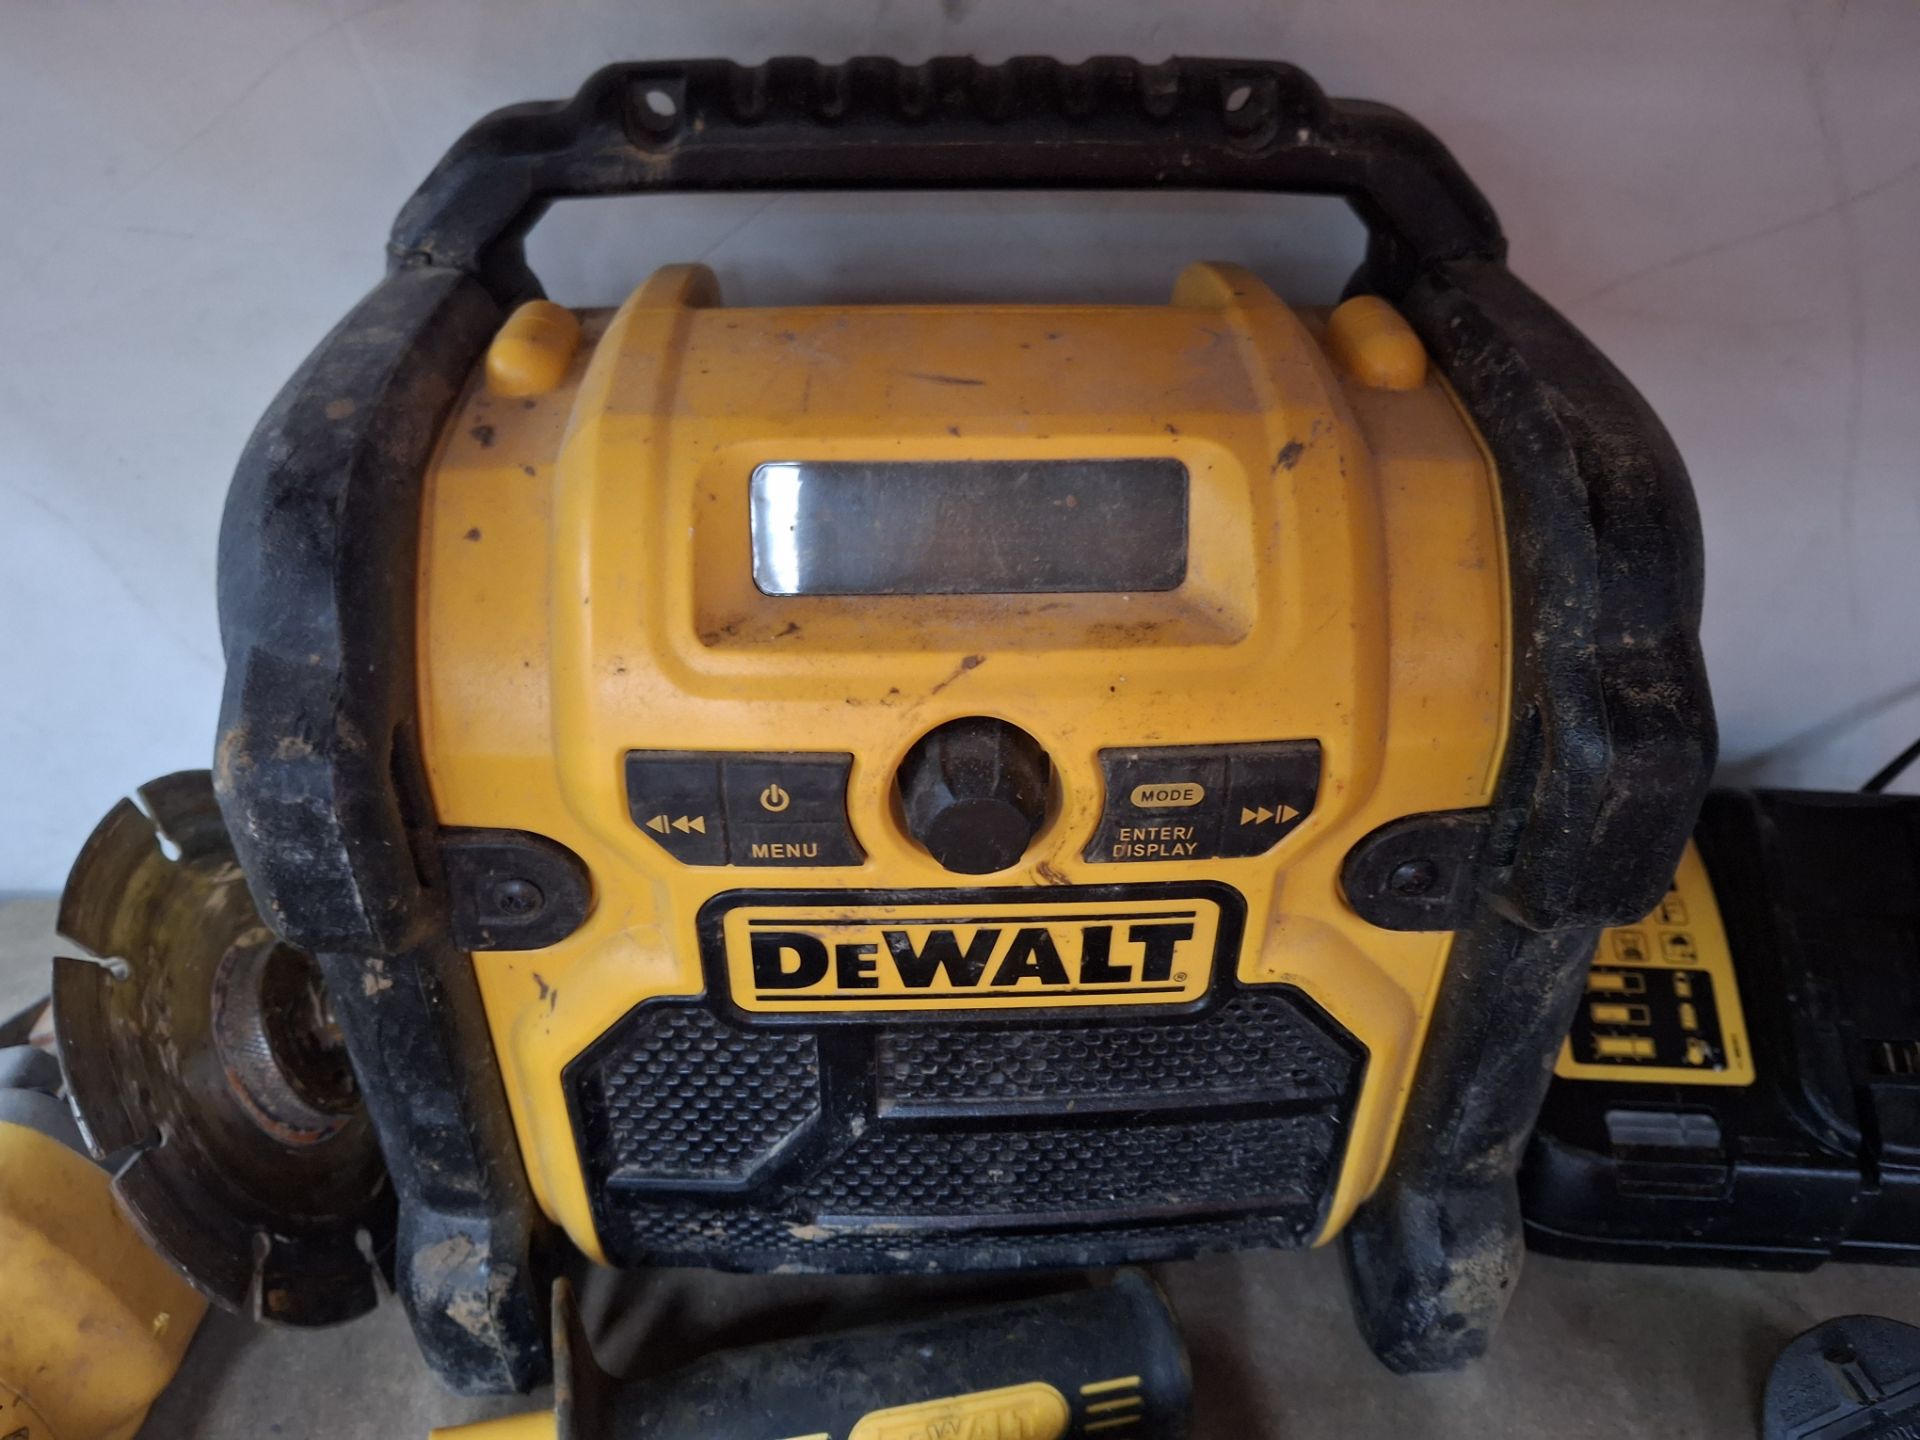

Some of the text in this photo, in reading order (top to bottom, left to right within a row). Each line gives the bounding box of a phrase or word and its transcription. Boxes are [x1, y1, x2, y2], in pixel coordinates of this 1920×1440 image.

[1141, 789, 1194, 802] MODE
[1120, 826, 1194, 841] ENTER/
[751, 843, 818, 858] MENU
[1112, 842, 1198, 857] DISPLAY
